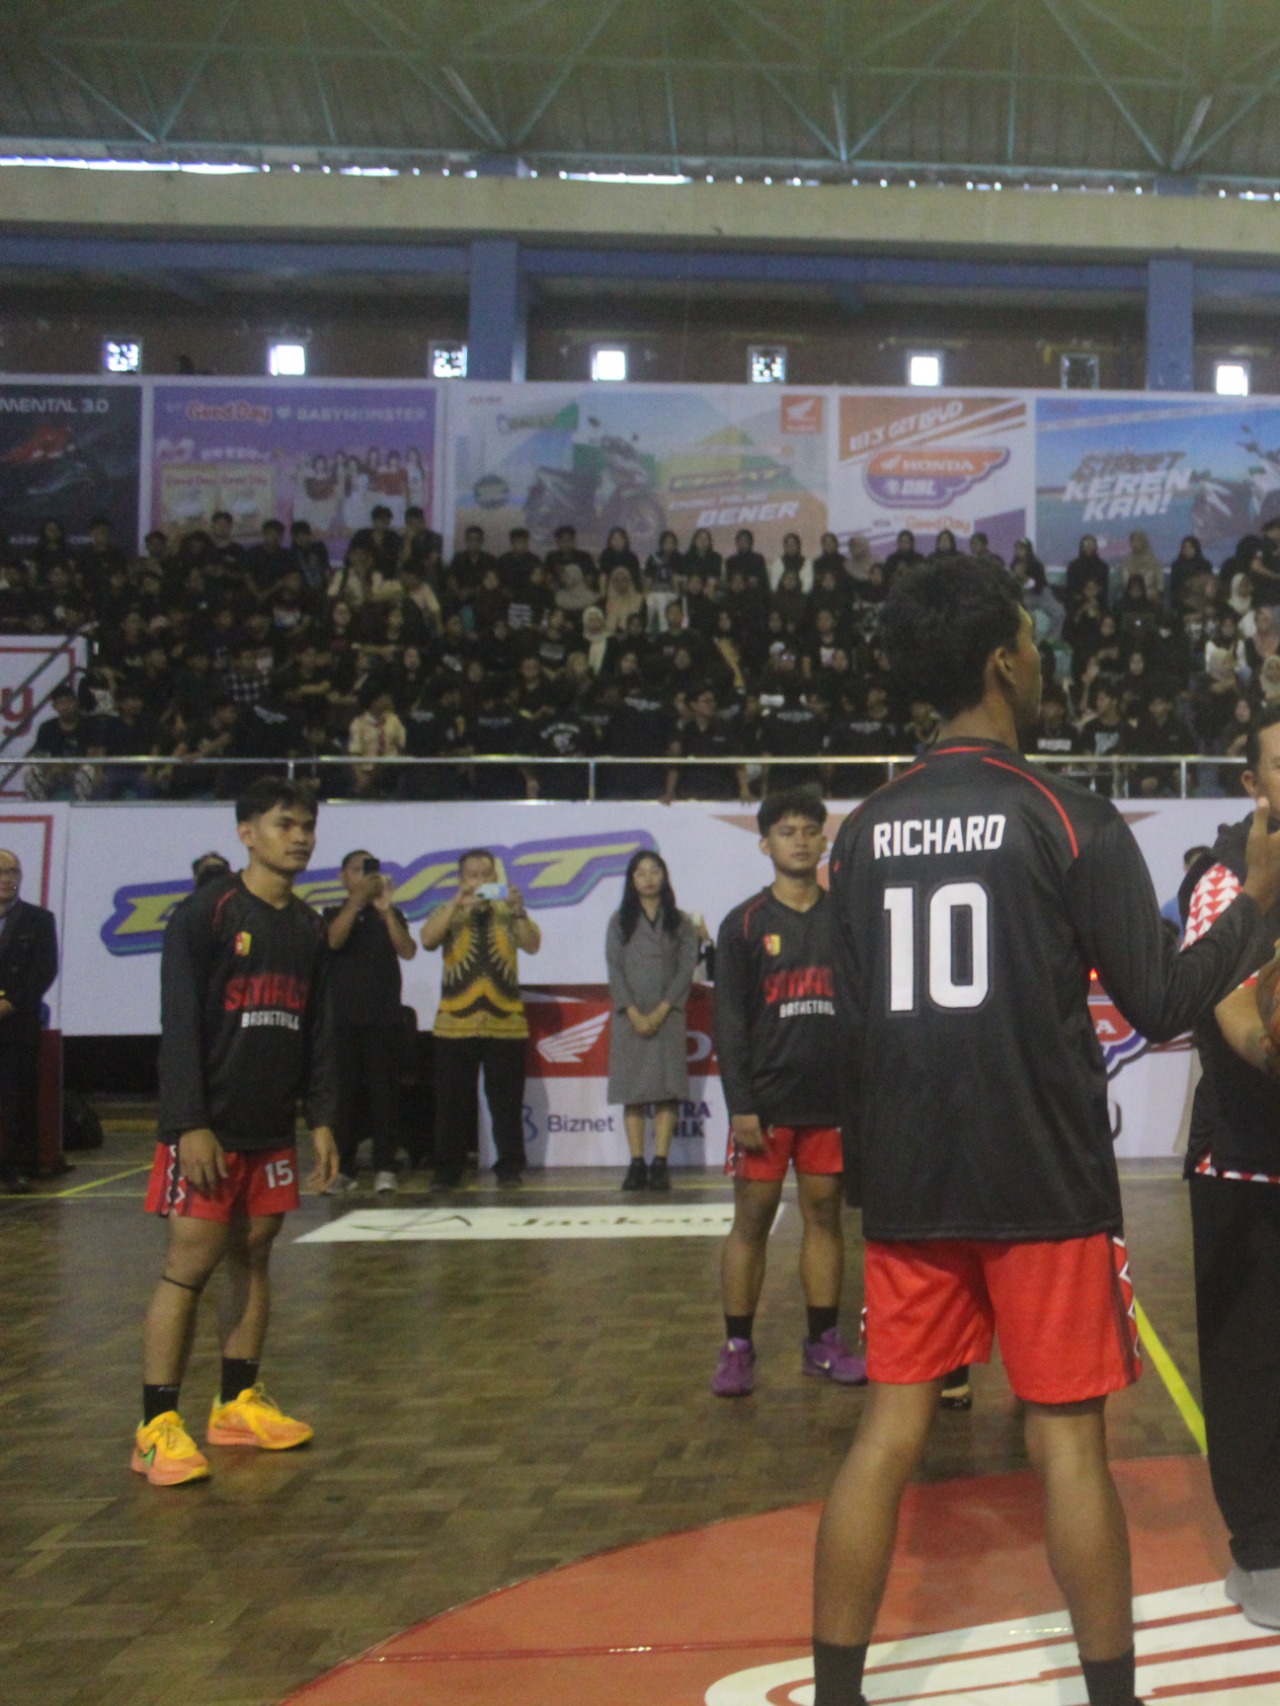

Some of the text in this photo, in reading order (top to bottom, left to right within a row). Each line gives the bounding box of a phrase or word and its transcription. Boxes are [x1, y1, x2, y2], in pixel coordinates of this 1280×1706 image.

[82, 398, 110, 413] 3.0
[903, 459, 974, 471] HONDA
[1062, 469, 1192, 502] KEREN
[1082, 493, 1174, 522] KAN!
[873, 814, 1006, 859] RICHARD
[884, 881, 989, 1012] 10
[546, 1114, 615, 1133] Biznet
[265, 1159, 294, 1189] 15
